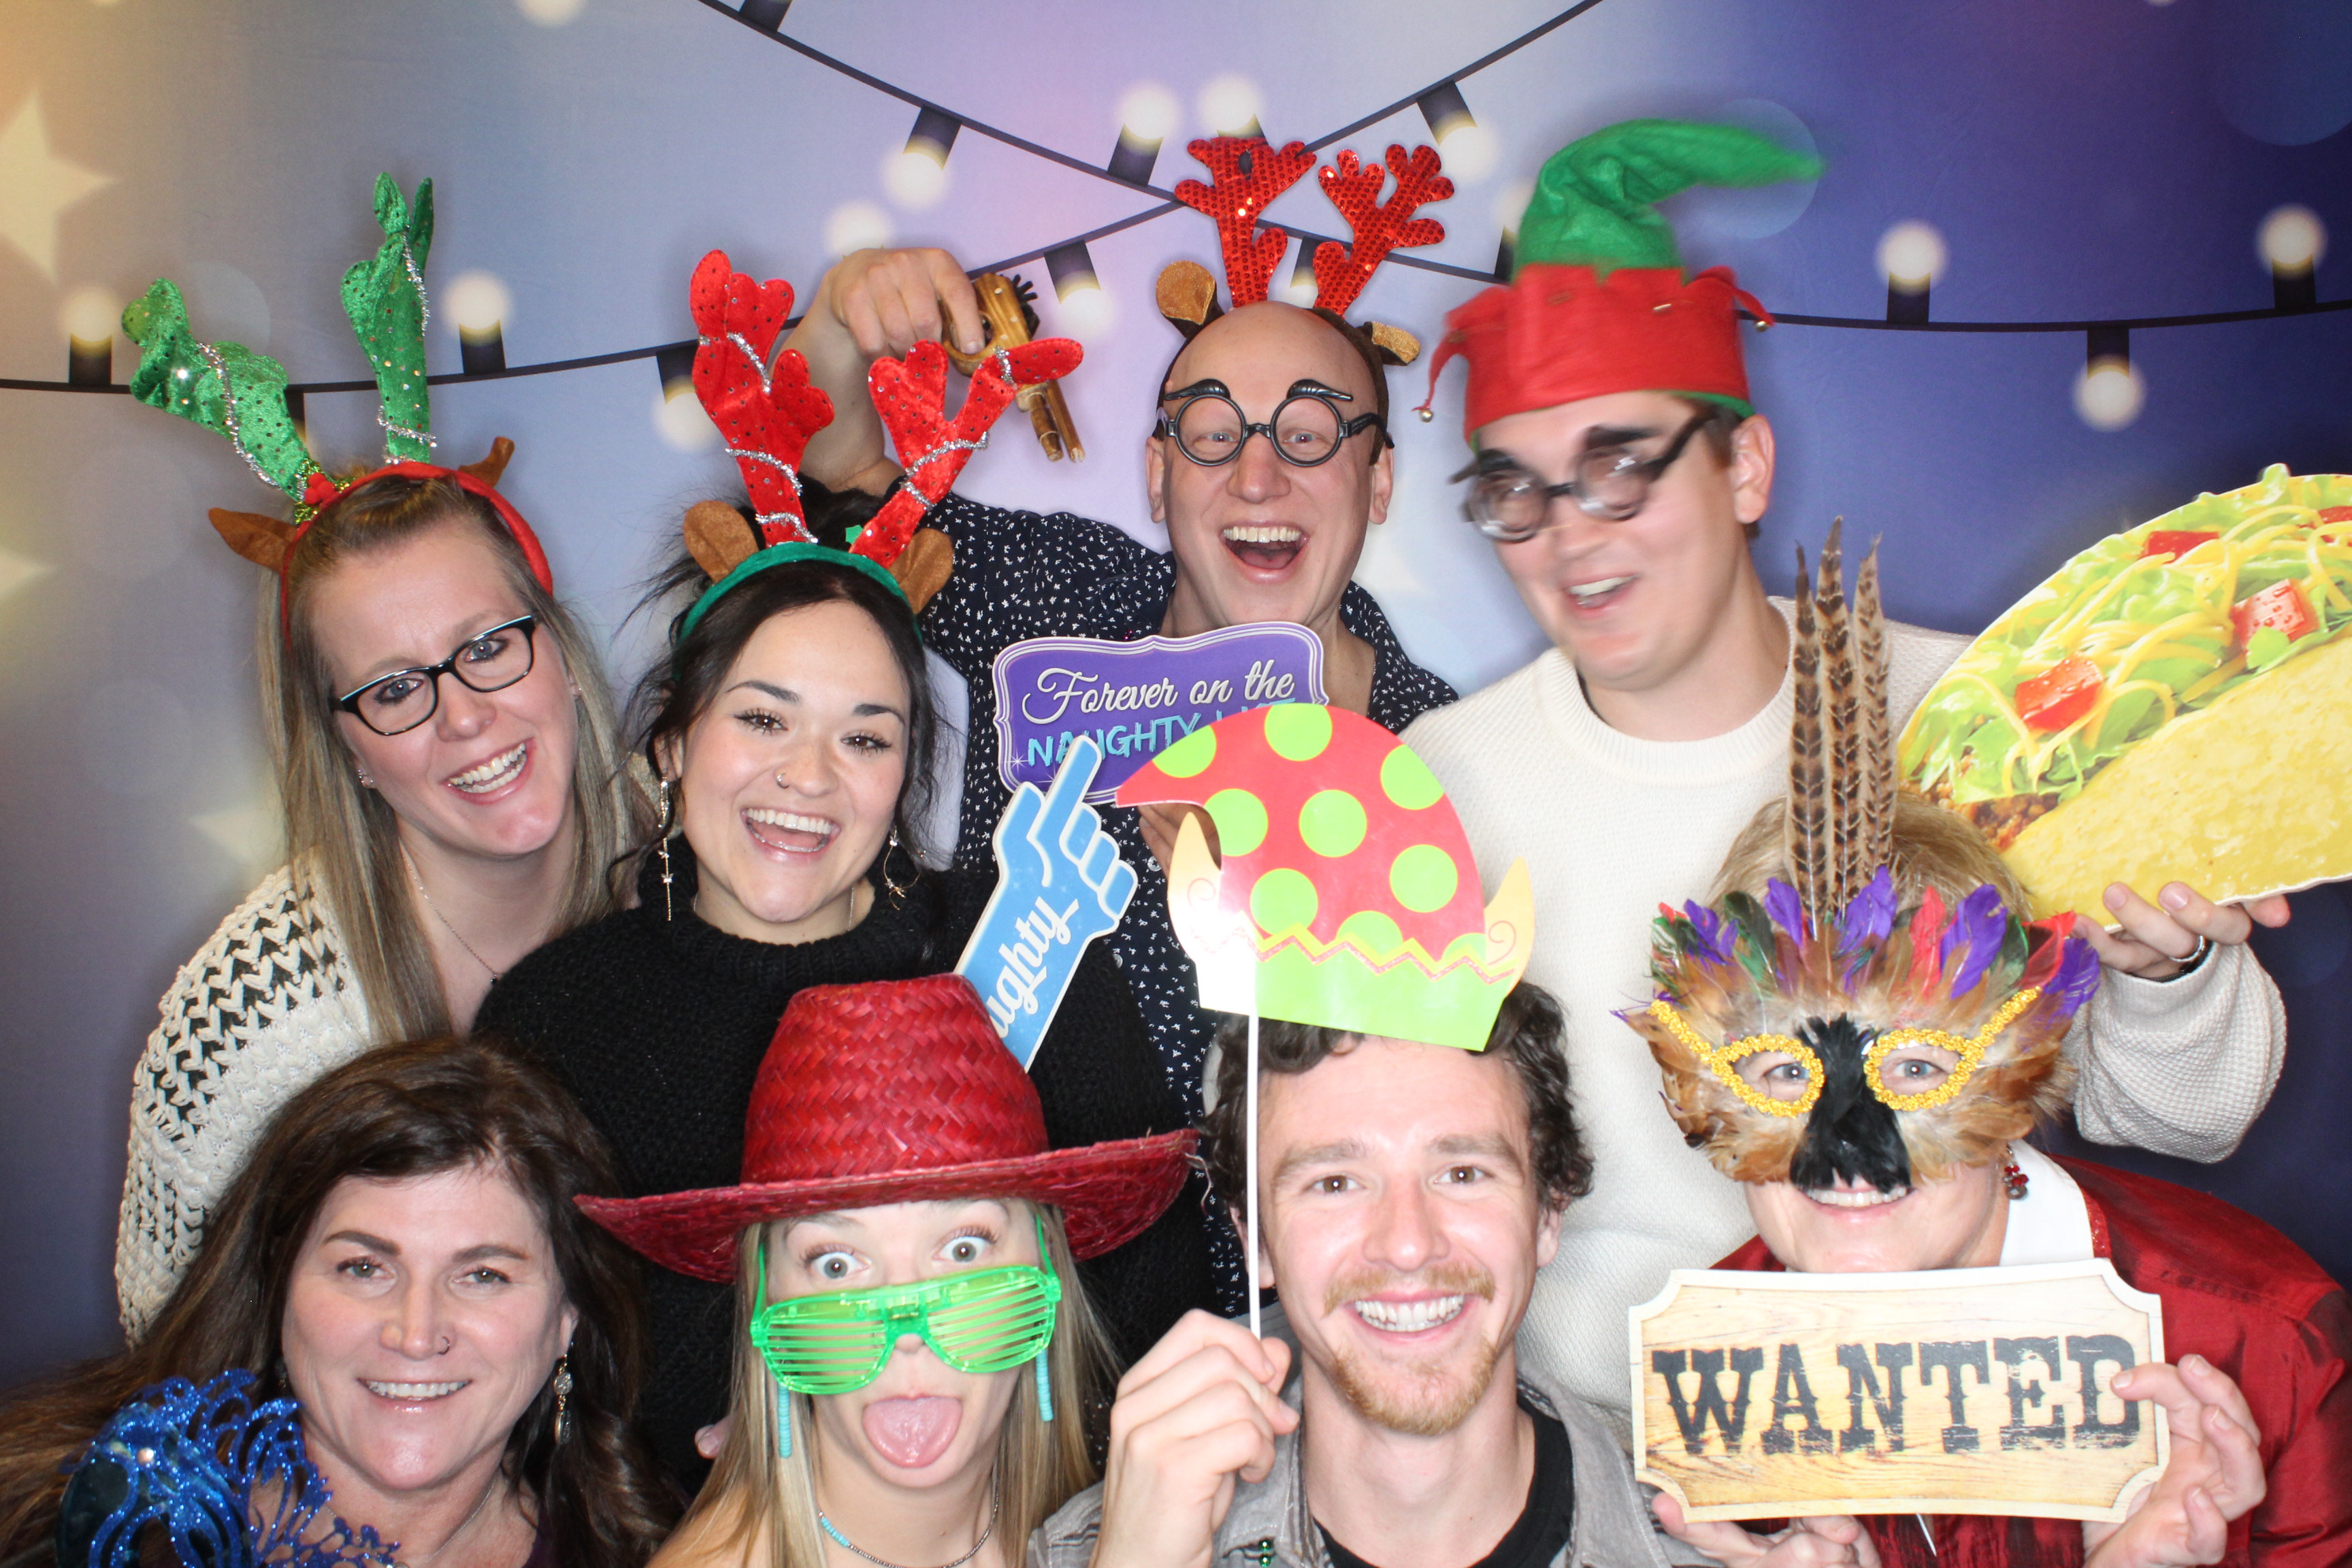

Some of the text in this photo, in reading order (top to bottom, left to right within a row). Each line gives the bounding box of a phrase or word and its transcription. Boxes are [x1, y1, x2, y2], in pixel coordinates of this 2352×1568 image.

[1022, 667, 1179, 725] Forever
[1190, 678, 1234, 705] on
[1243, 659, 1296, 701] the
[986, 896, 1079, 1039] ughty
[1651, 1334, 2142, 1455] WANTED
